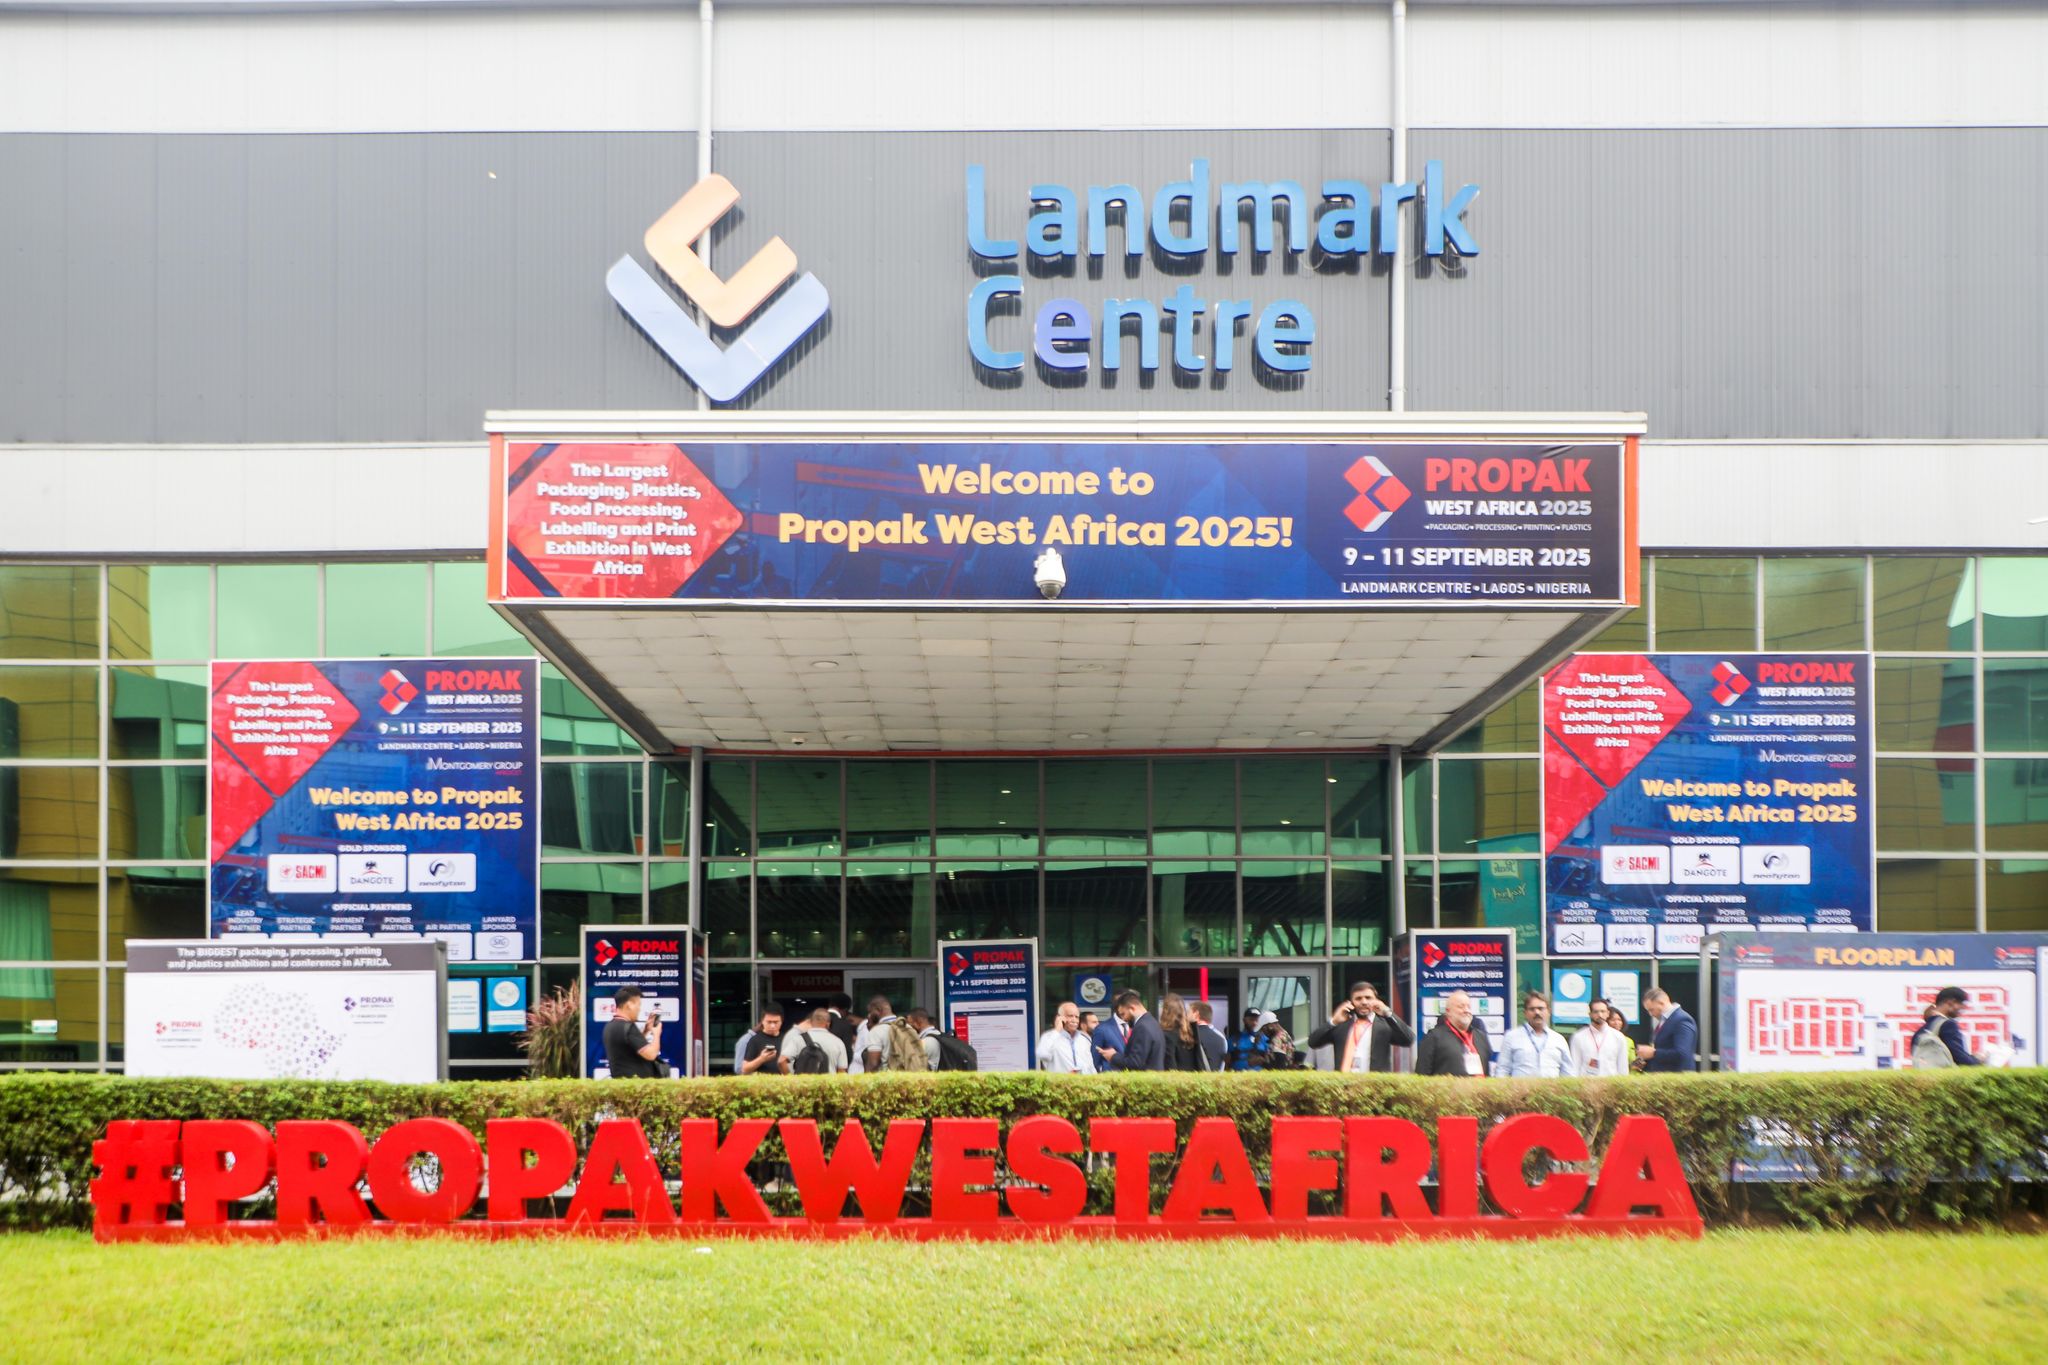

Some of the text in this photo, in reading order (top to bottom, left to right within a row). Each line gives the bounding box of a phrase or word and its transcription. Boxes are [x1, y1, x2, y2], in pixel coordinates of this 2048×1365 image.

[966, 159, 1480, 258] Landmark
[967, 275, 1315, 373] Centre
[570, 463, 668, 481] The Largest
[1425, 458, 1592, 492] PROPAK
[918, 464, 1154, 495] Welcome to
[537, 482, 701, 500] Packaging, Plastics,
[550, 502, 688, 519] Food Processing,
[1426, 500, 1592, 516] WEST AFRICA 2025
[541, 521, 696, 539] Labelling and Print
[779, 512, 1293, 552] Propak West Africa 2025!
[546, 541, 691, 556] Exhibition in West
[1344, 548, 1358, 566] 9
[1382, 548, 1405, 566] 11
[1410, 548, 1534, 566] SEPTEMBER
[1538, 548, 1590, 566] 2025
[593, 560, 644, 576] Africa
[1342, 582, 1592, 594] LANDMARK CENTRE LAGOS NIGERIA
[1578, 673, 1644, 684] The Largest
[1758, 663, 1855, 683] PROPAK
[426, 670, 522, 690] PROPAK
[249, 681, 314, 693] The Largest
[1557, 686, 1666, 698] Packaging, Plastics,
[1756, 686, 1855, 696] WEST AFRICA 2025
[226, 694, 335, 706] Packaging, Plastics,
[425, 694, 522, 704] WEST AFRICA 2025
[1566, 699, 1657, 710] Food Processing,
[235, 707, 326, 720] Food Processing,
[1560, 712, 1664, 723] Labelling and Print
[229, 720, 332, 732] Labelling and Print
[1710, 714, 1856, 726] 9 11 SEPTEMBER 2025
[378, 722, 522, 734] 9 11 SEPTEMBER 2025
[1563, 724, 1661, 734] Exhibition in West
[232, 732, 330, 743] Exhibition in West
[1595, 738, 1629, 748] Africa
[1710, 734, 1756, 742] LANDMARK
[1756, 734, 1787, 742] CENTRE
[264, 746, 298, 756] Africa
[378, 742, 422, 750] LANDMARK
[424, 742, 454, 750] CENTRE
[494, 762, 523, 770] GROUP
[1641, 778, 1857, 800] Welcome to Propak
[308, 786, 524, 809] Welcome to Propak
[1668, 804, 1857, 822] West Africa 2025
[334, 812, 523, 830] West Africa 2025
[1629, 857, 1660, 870] SACMI
[296, 865, 326, 879] SACMI
[1615, 937, 1646, 946] KPMG
[1665, 934, 1698, 944] verto
[622, 940, 678, 952] PROPAK
[1448, 943, 1503, 954] PROPAK
[176, 948, 195, 956] The
[239, 948, 289, 958] packaging,
[290, 947, 342, 958] processing,
[344, 947, 382, 956] printing
[973, 950, 1024, 962] PROPAK
[1814, 946, 1954, 968] FLOORPLAN
[167, 958, 392, 970] and plastics exhibition and conference in AFRICA.
[791, 976, 840, 986] VISITOR
[91, 1113, 1701, 1228] #PROPAKWESTAFRICA
